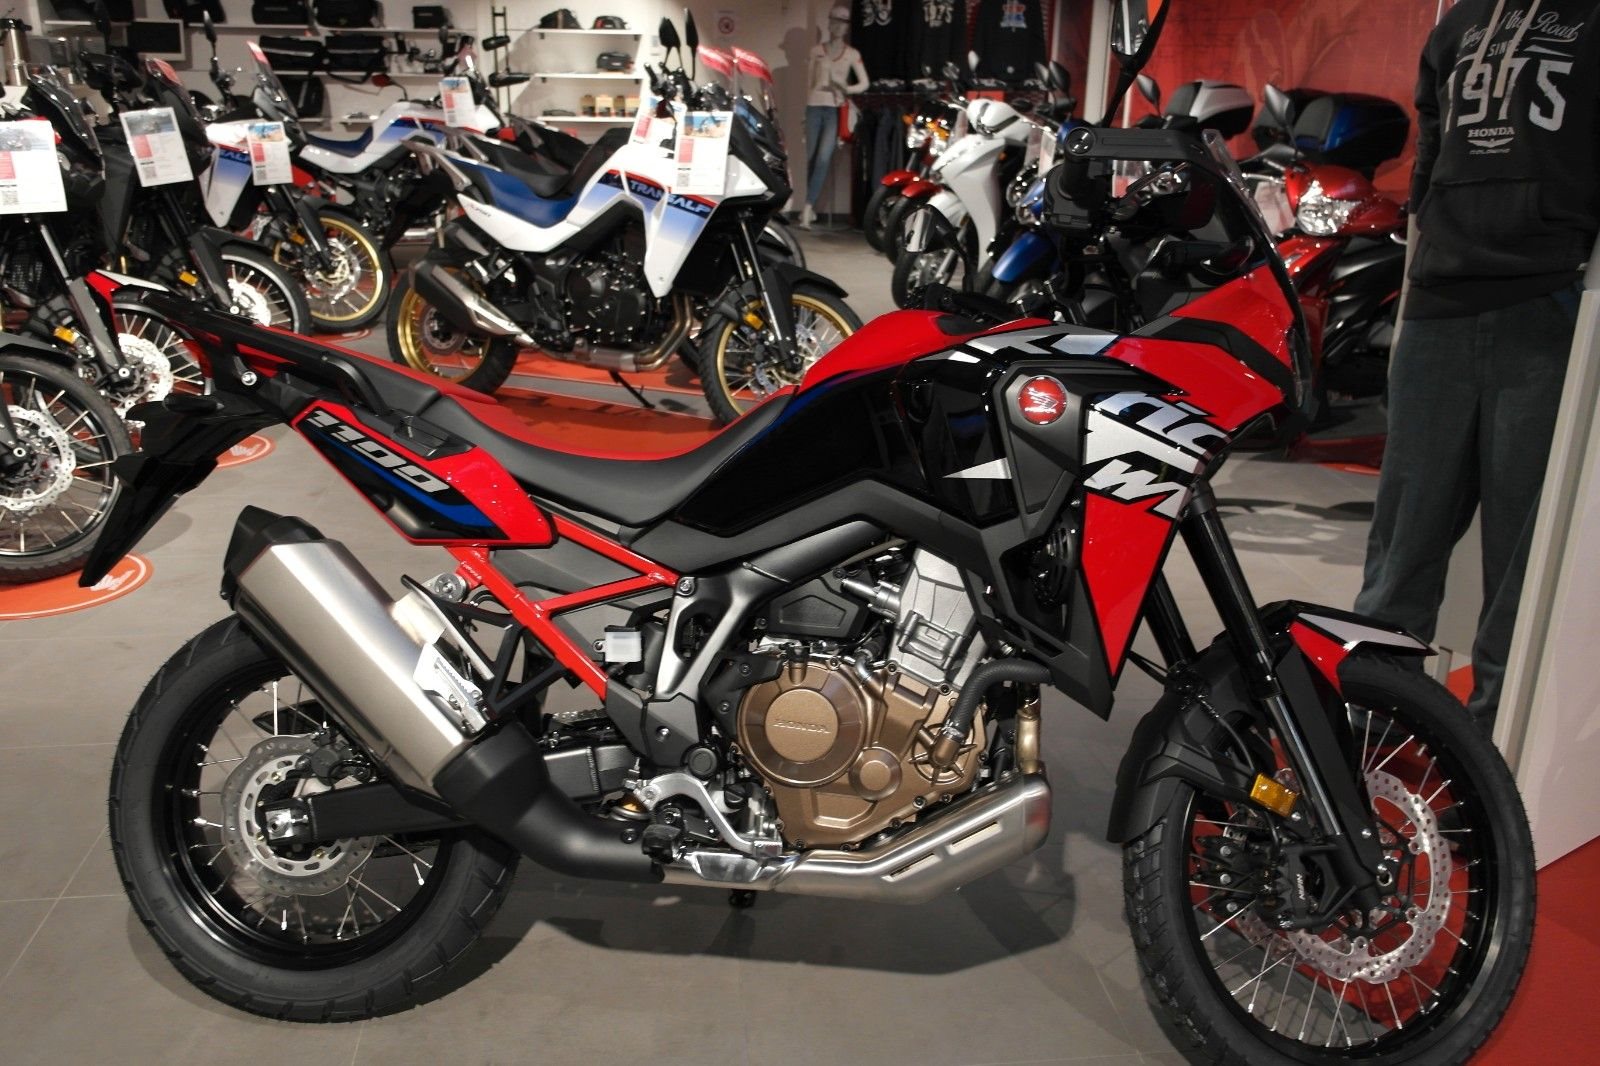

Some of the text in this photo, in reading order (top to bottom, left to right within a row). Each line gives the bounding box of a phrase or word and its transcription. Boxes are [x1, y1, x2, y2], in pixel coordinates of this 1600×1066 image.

[1529, 11, 1584, 39] Road
[1445, 57, 1573, 132] 1975
[1467, 126, 1515, 137] HONDA
[630, 180, 711, 213] TRANSALP
[306, 410, 450, 493] 1100
[772, 718, 832, 734] HONDA
